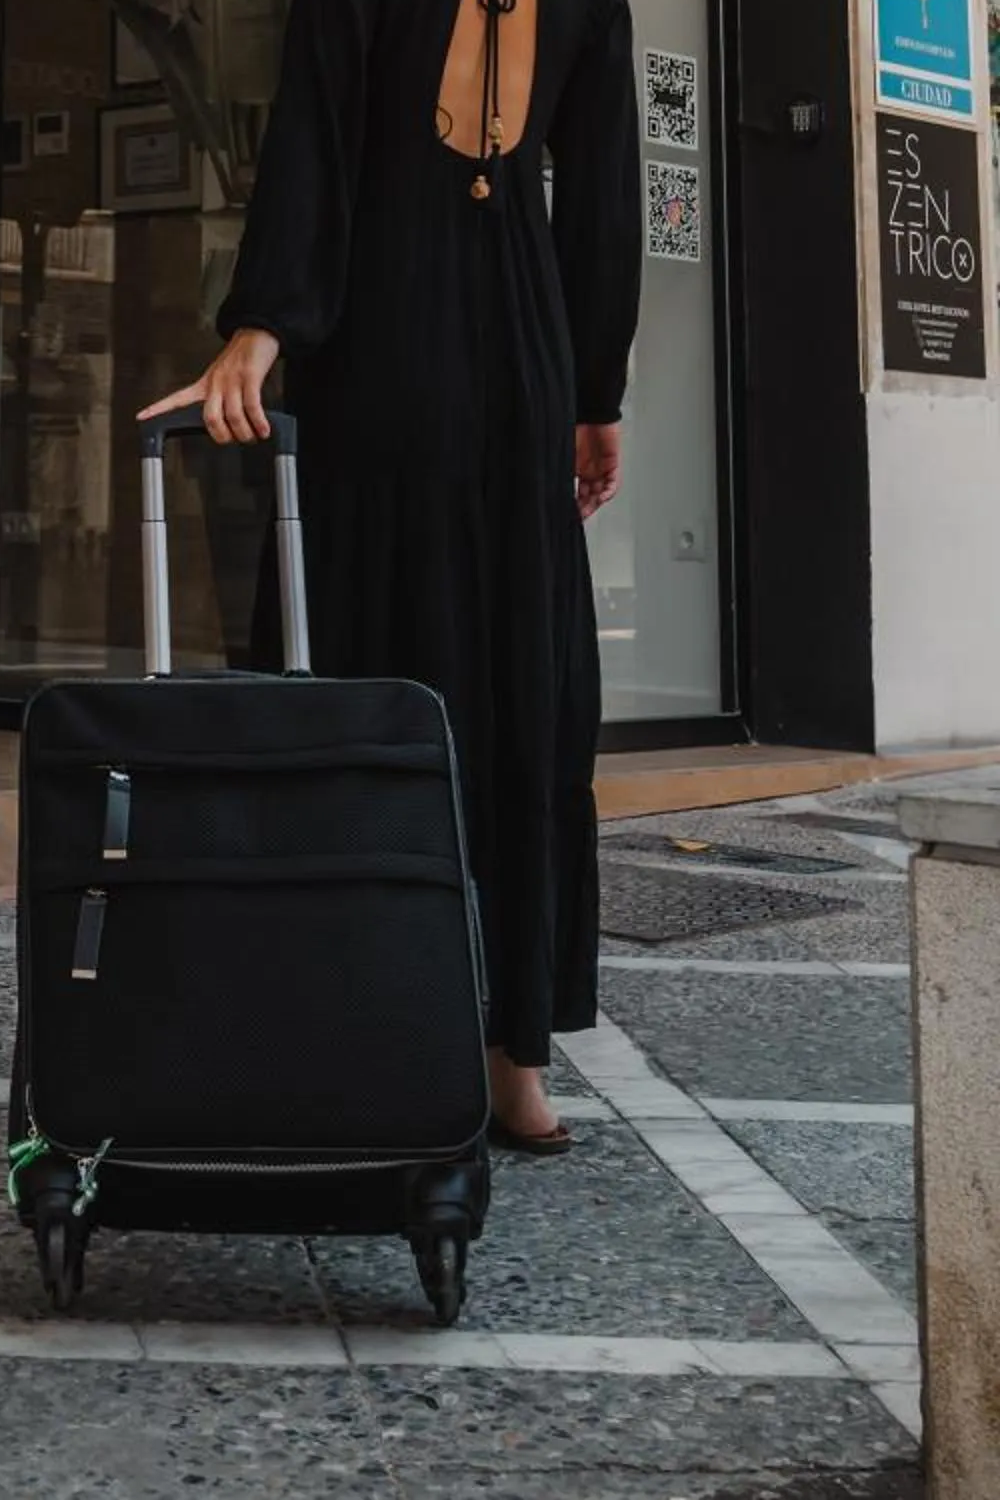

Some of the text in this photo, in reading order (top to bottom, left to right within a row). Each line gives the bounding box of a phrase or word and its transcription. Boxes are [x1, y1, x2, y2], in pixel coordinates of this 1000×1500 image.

[901, 79, 953, 107] CIUDAD
[885, 128, 921, 179] ES
[887, 179, 950, 233] ZEN
[889, 229, 975, 283] TRICO
